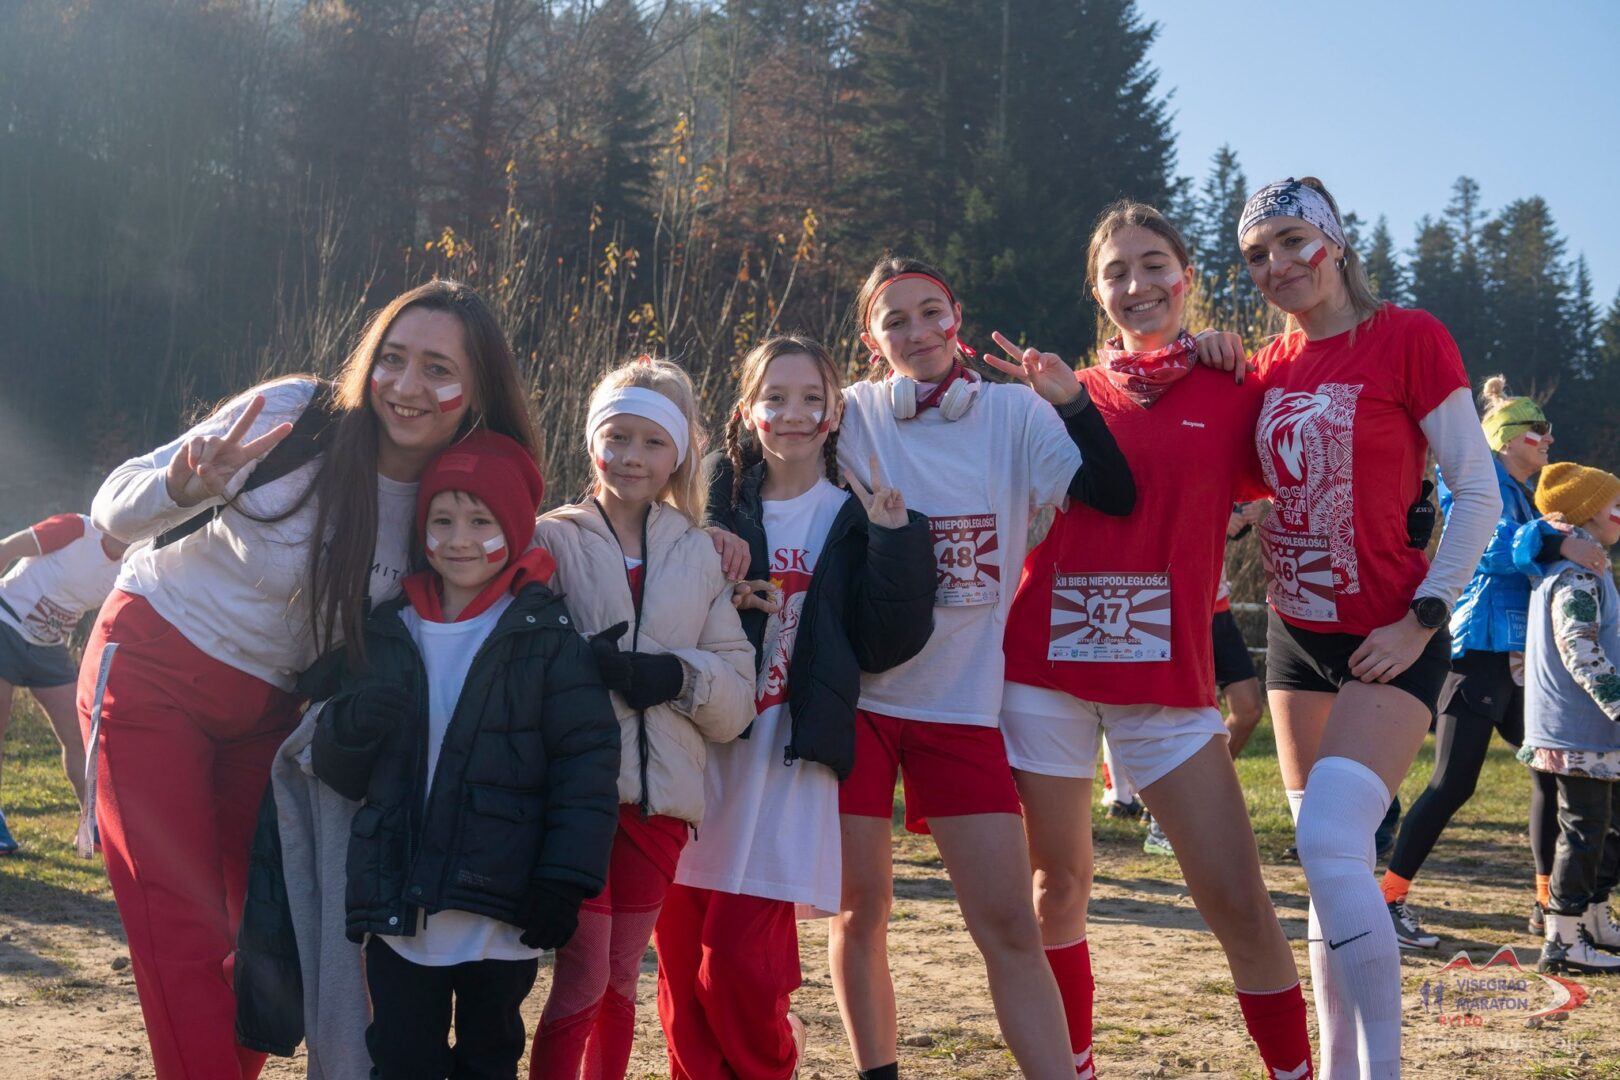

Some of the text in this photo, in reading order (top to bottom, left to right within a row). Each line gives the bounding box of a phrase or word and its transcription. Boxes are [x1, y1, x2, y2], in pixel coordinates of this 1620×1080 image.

[939, 546, 972, 569] 48
[1055, 574, 1168, 587] XII BIEG NIEPODLEGŁOŚCI
[1275, 559, 1294, 582] 46
[1092, 602, 1123, 624] 47
